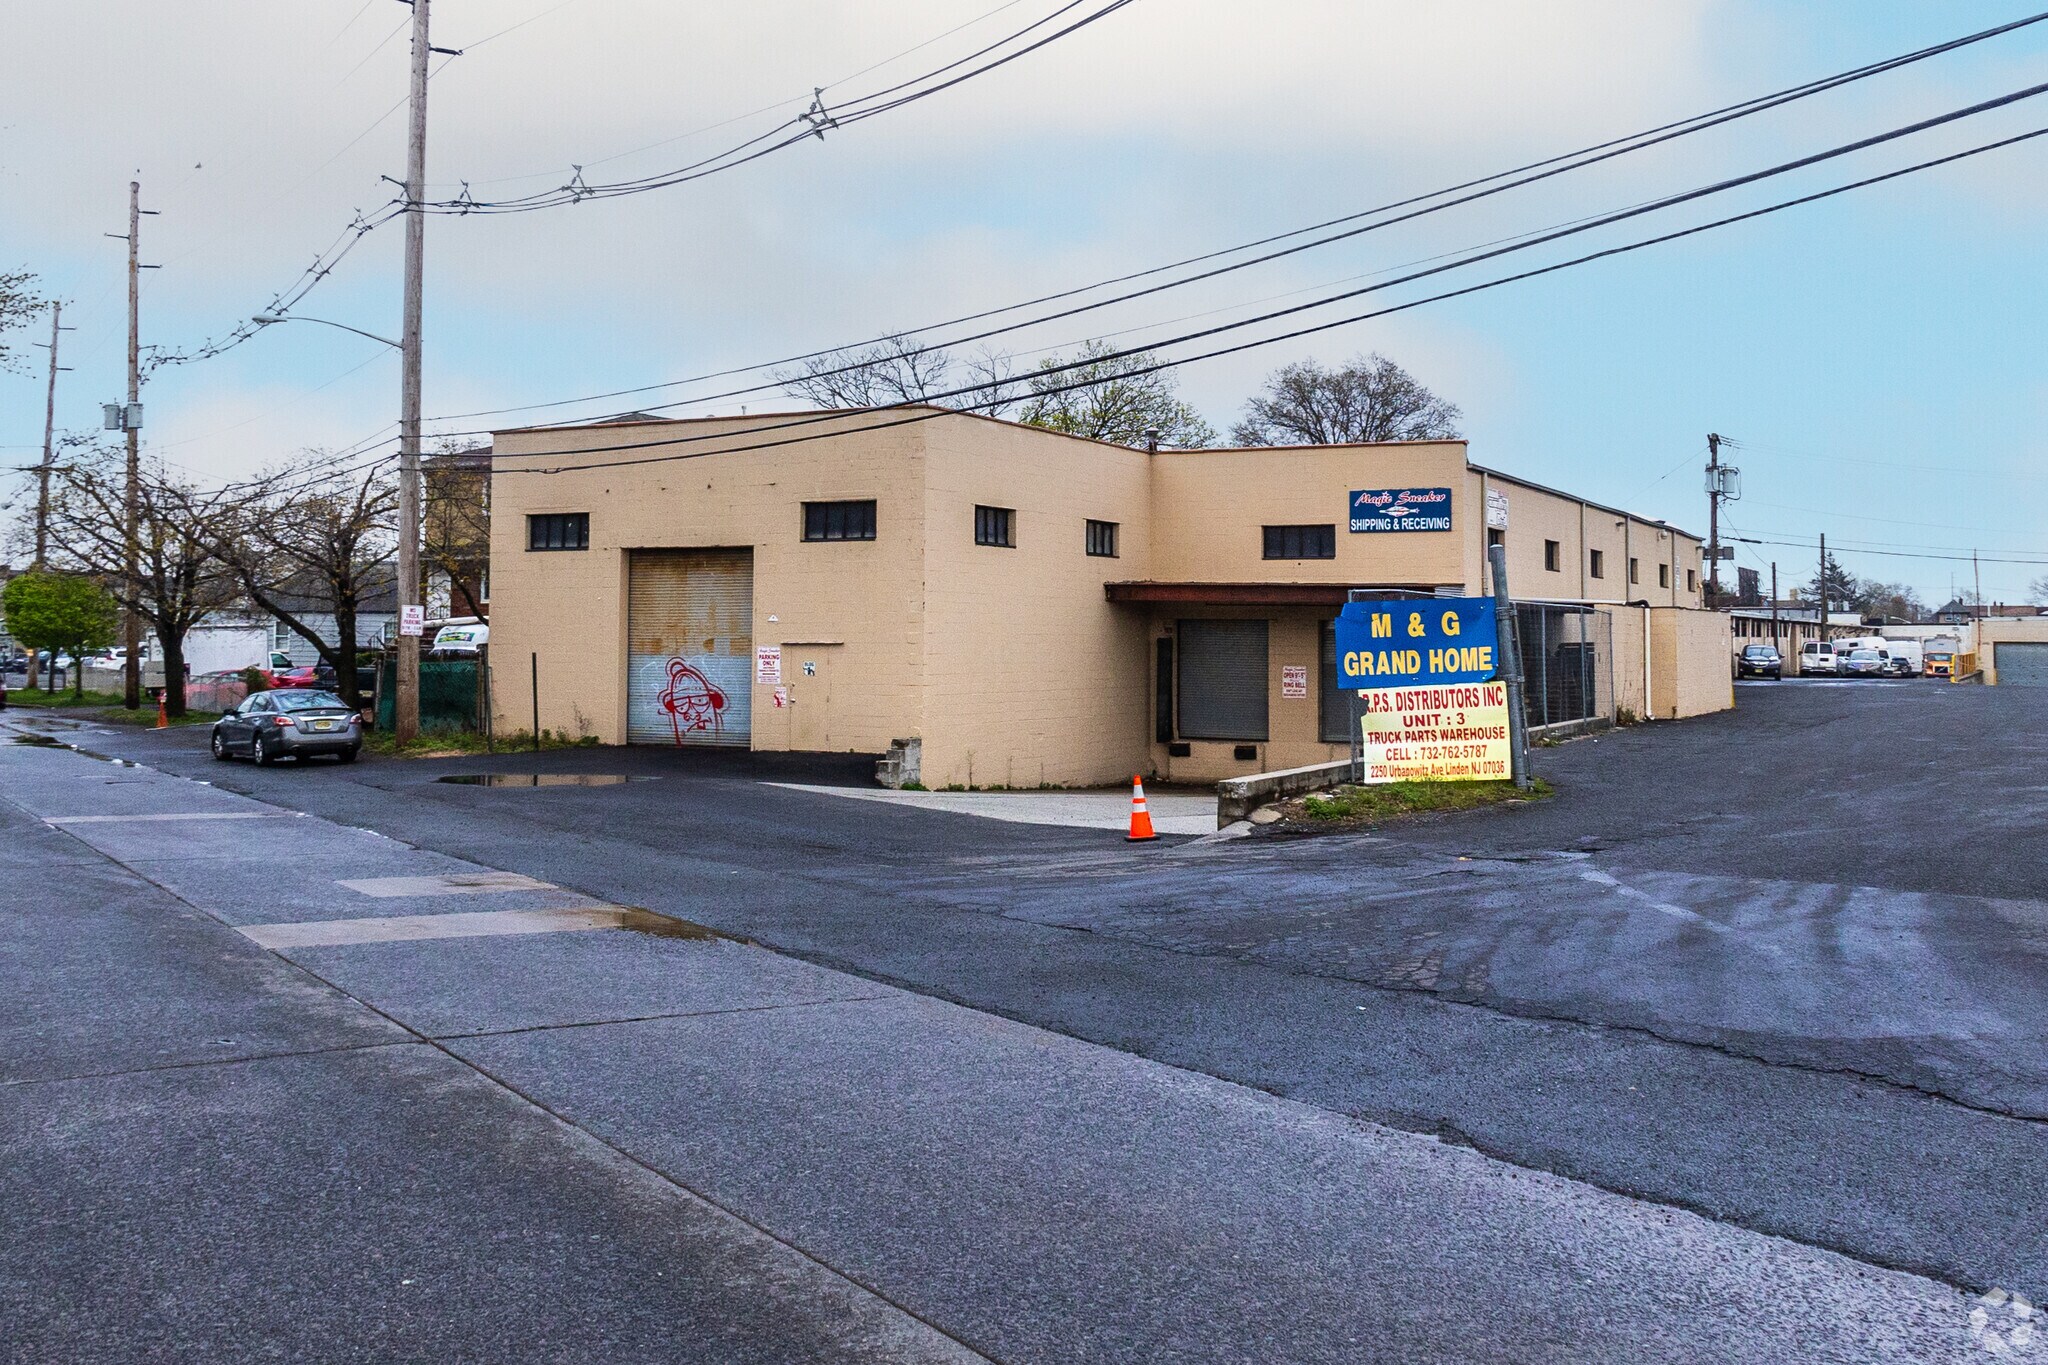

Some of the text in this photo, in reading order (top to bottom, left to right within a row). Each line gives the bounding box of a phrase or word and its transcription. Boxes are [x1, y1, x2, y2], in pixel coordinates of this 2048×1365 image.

[1354, 490, 1446, 507] Magic Sneaker
[1350, 517, 1450, 531] SHIPPING & RECEIVING
[1371, 611, 1461, 638] M & G
[1344, 646, 1493, 676] GRAND HOME
[1396, 688, 1480, 711] DISTRIBUTORS
[1483, 686, 1504, 707] INC
[1403, 714, 1441, 727] UNIT
[1456, 713, 1465, 725] 3
[1367, 726, 1505, 745] TRUCK PARTS WAREHOUSE
[1386, 748, 1412, 761] CELL
[1420, 745, 1488, 760] 732-762-5787
[1370, 765, 1388, 778] 2250
[1430, 763, 1443, 776] Ave
[1445, 762, 1470, 776] Linden
[1471, 761, 1481, 775] NJ
[1483, 761, 1505, 775] 07036
